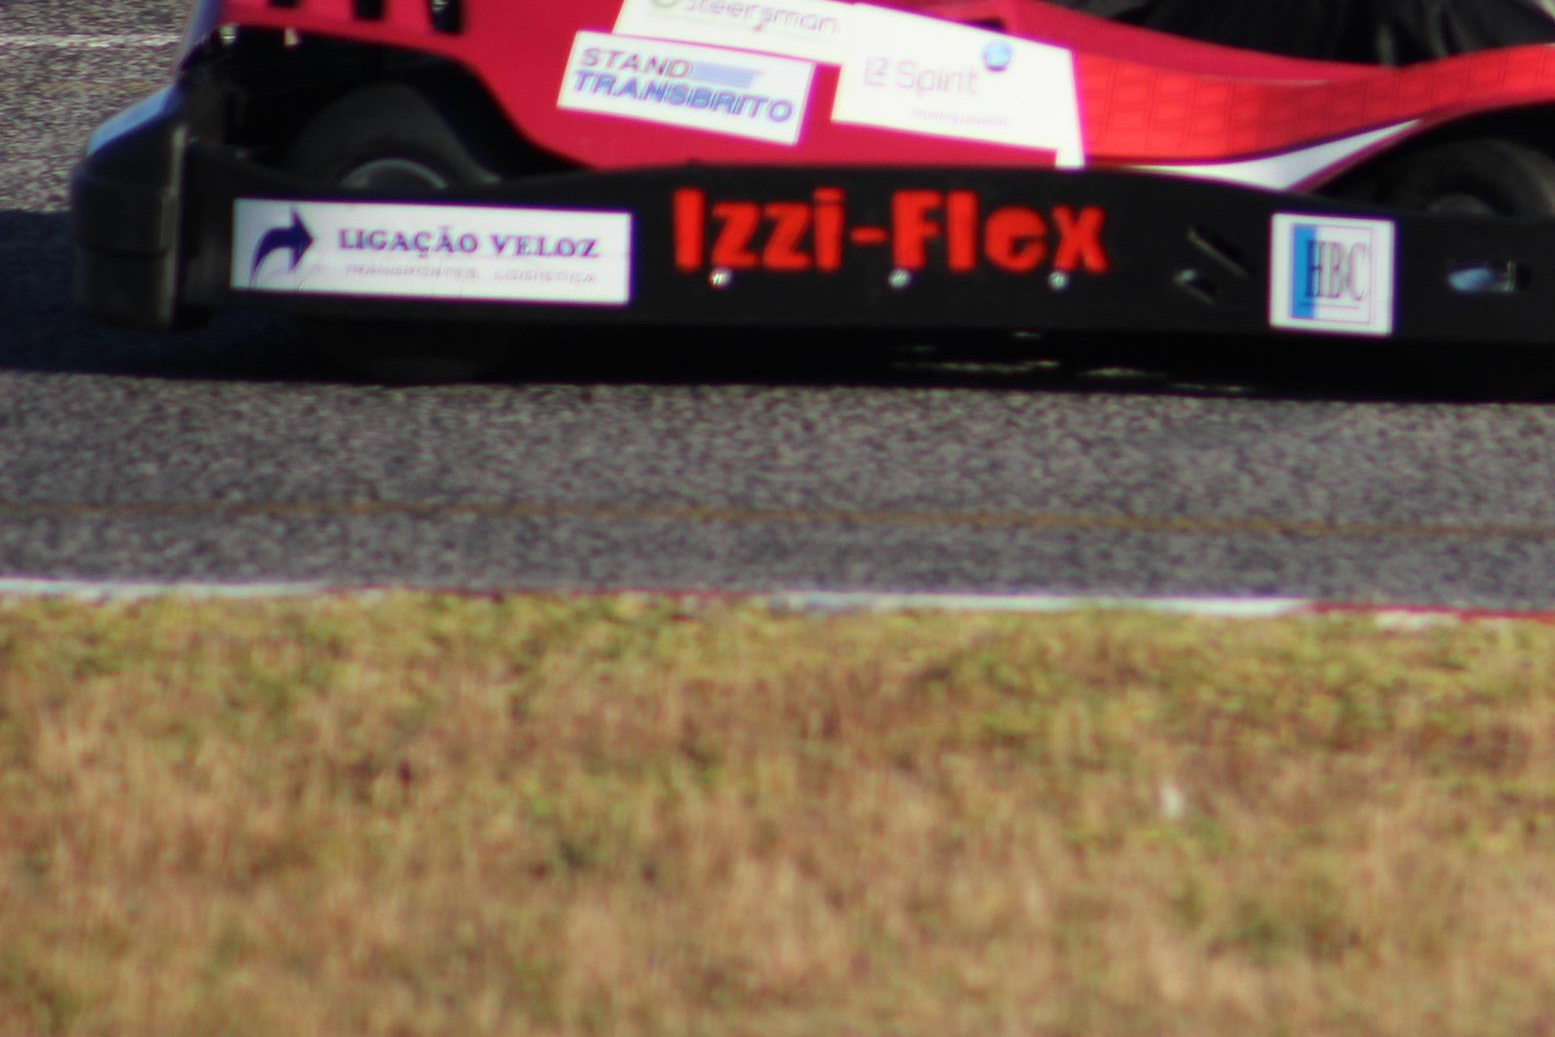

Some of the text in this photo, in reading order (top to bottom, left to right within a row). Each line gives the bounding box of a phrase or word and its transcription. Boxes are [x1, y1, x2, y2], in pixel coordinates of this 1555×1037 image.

[580, 47, 693, 80] STAND
[895, 59, 979, 97] Spirit
[573, 69, 794, 124] TRANSBRITO
[337, 224, 601, 259] LIGAÇÃO VELOZ
[672, 188, 1108, 274] Izzi-Flex
[1305, 239, 1369, 302] HBC
